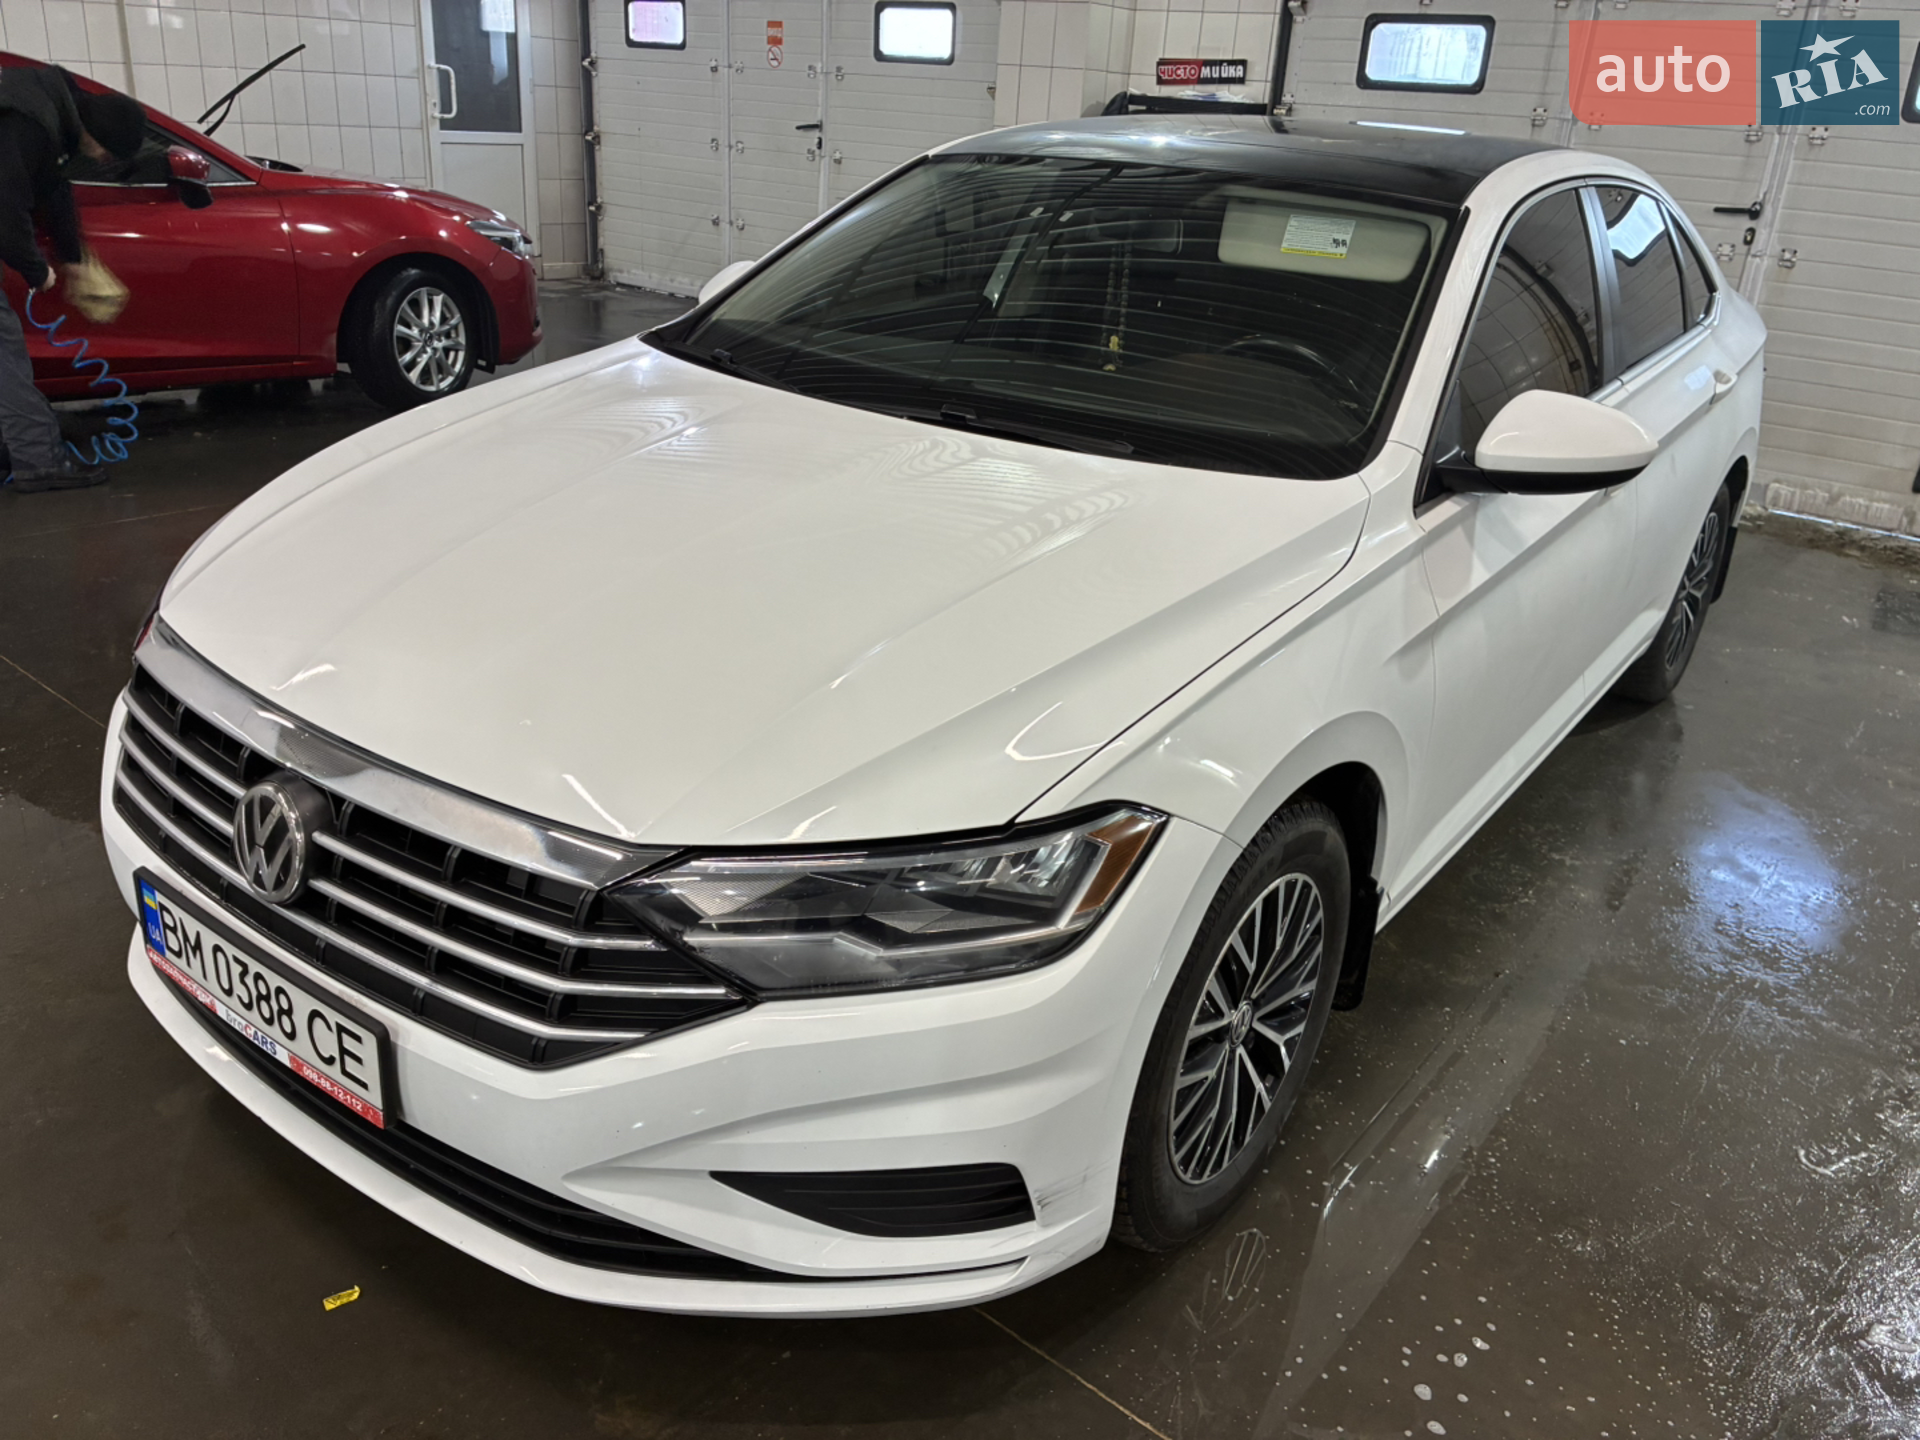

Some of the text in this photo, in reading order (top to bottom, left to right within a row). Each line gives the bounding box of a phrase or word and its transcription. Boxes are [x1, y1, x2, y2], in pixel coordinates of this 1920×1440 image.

[148, 922, 162, 944] UA
[158, 900, 208, 982] BM
[212, 942, 297, 1041] 0388
[307, 1008, 369, 1092] CE
